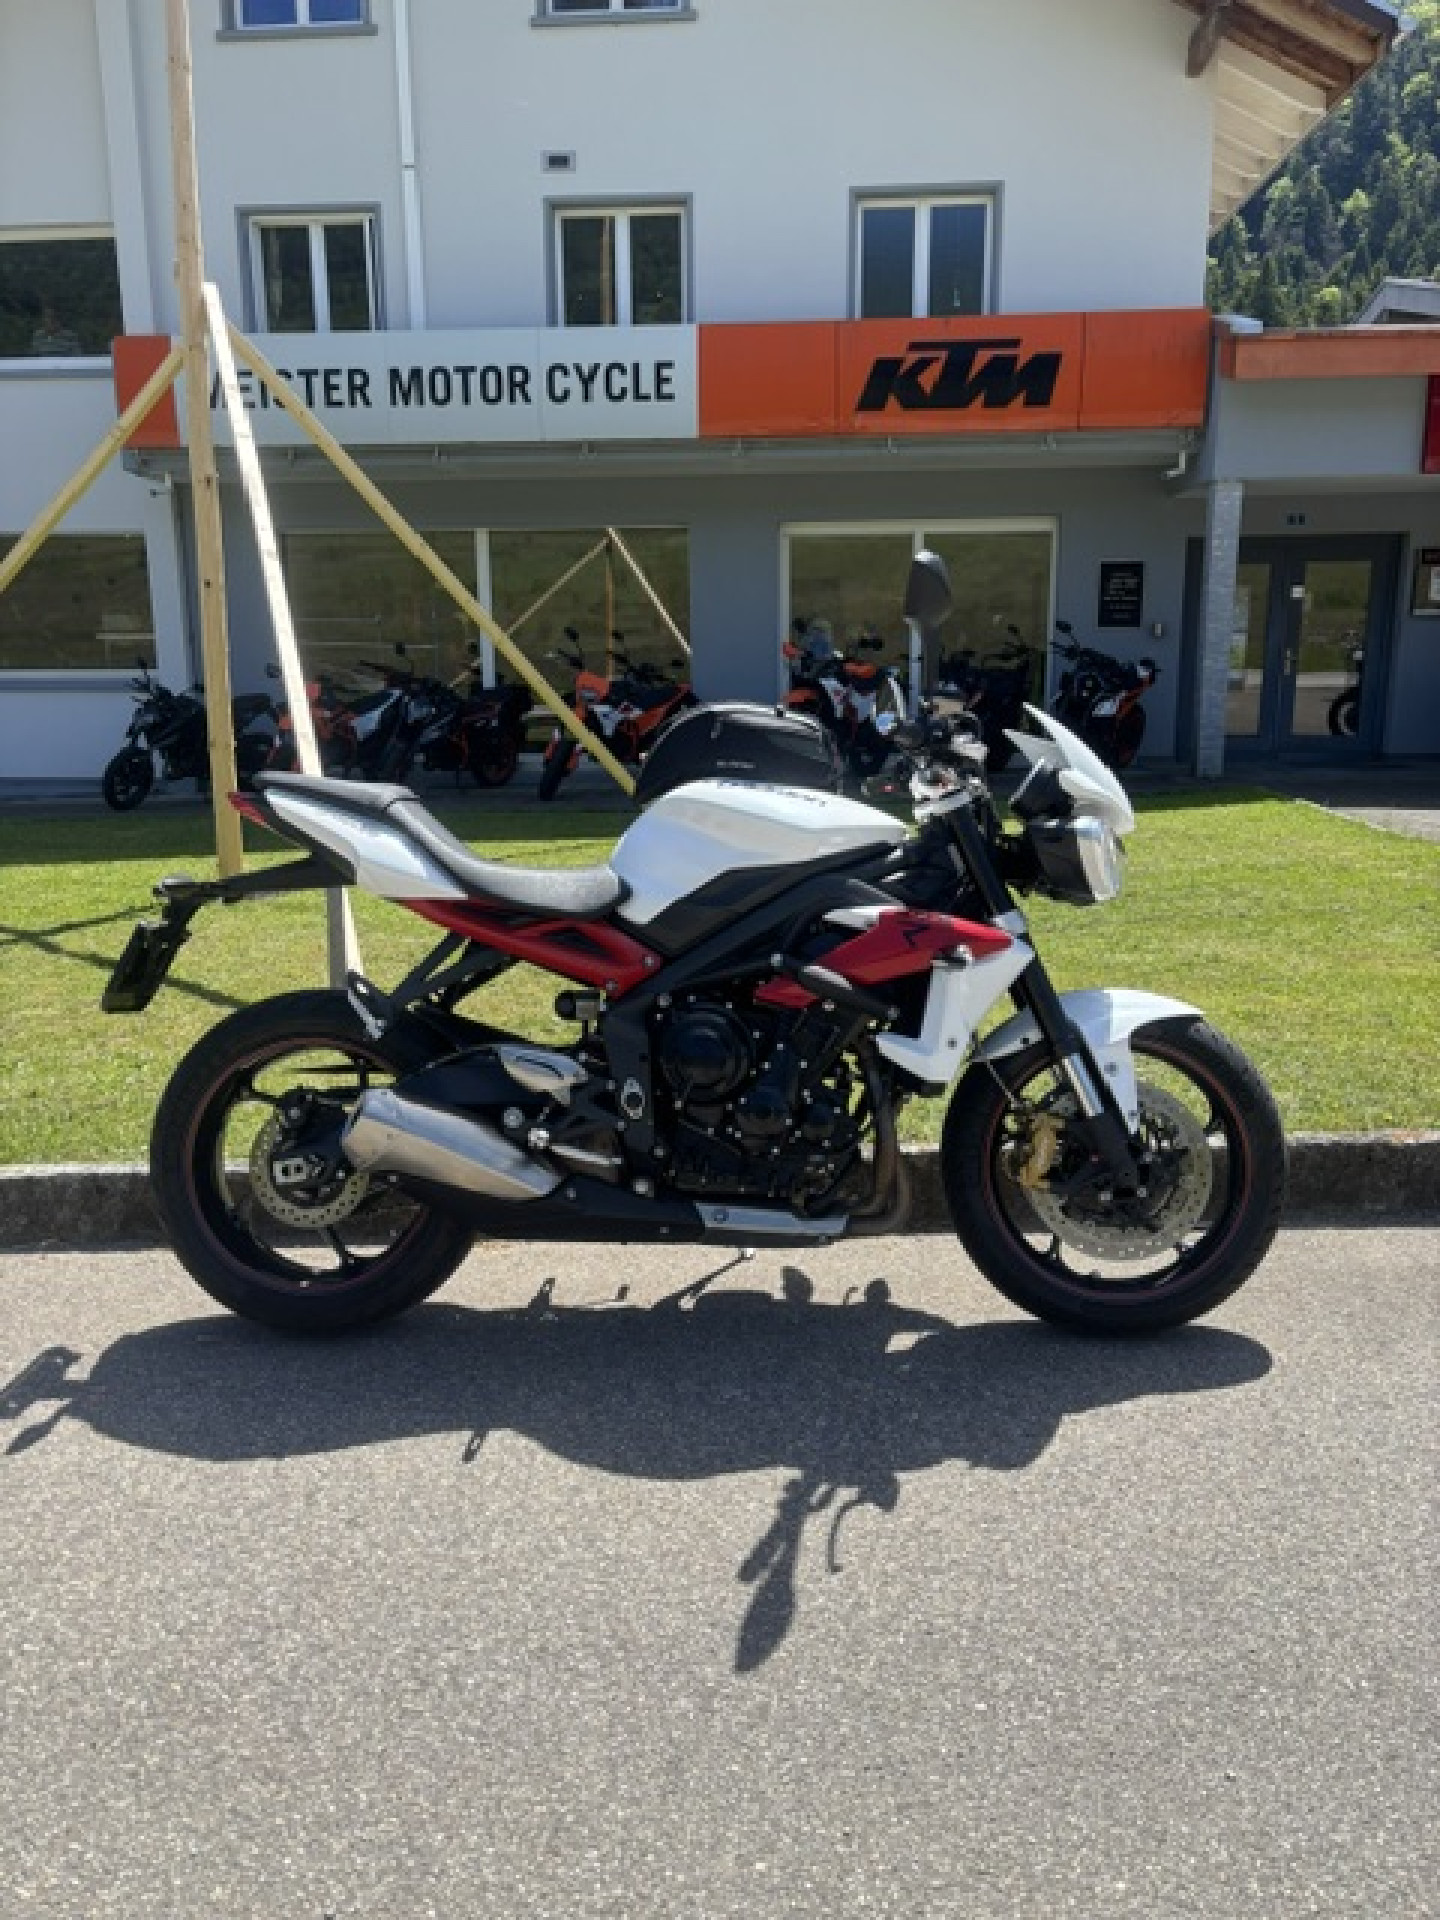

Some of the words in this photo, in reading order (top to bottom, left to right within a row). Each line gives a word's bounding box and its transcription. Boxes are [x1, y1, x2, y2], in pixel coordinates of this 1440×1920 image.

[388, 365, 532, 408] MOTOR
[546, 360, 676, 403] CYCLE
[856, 338, 1063, 411] KTM
